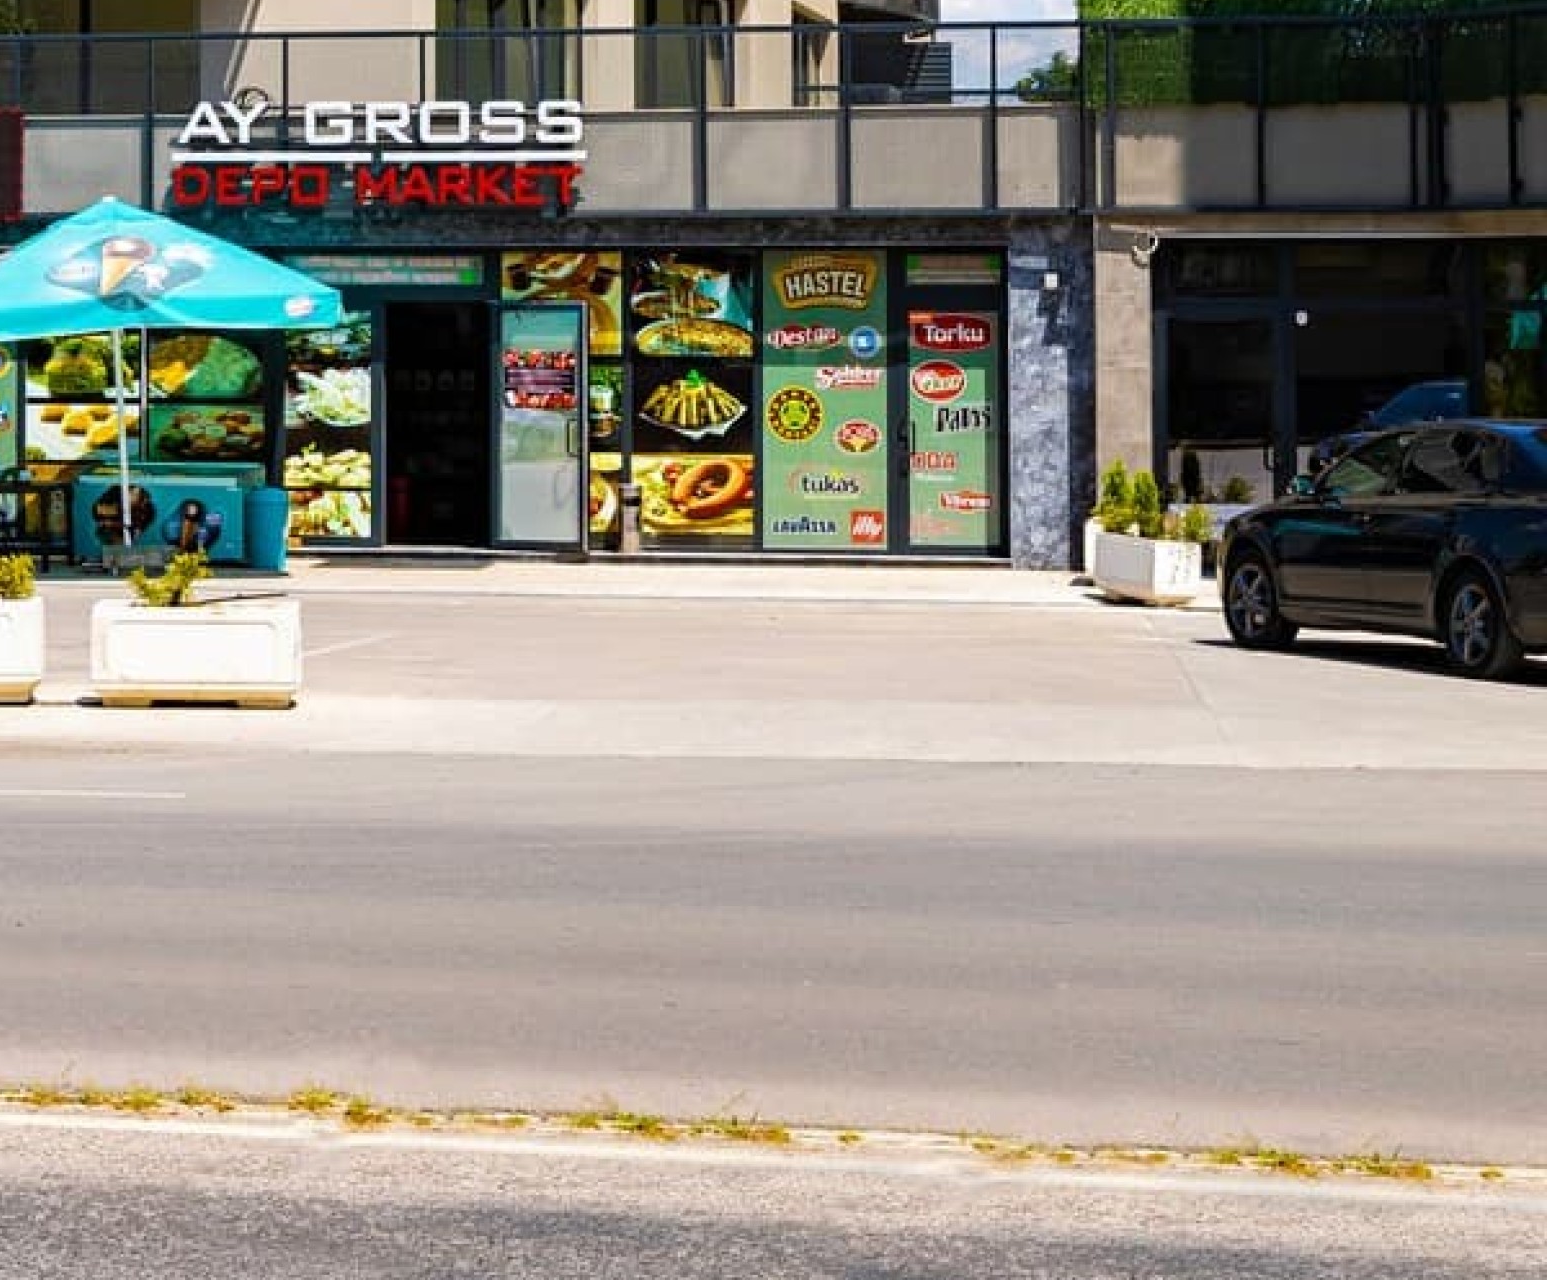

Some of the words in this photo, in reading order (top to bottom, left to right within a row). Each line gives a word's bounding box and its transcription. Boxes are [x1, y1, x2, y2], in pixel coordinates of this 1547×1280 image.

[178, 100, 269, 145] AY
[305, 100, 584, 145] GROSS
[171, 164, 330, 208] DEPO
[354, 164, 584, 208] MARKET
[784, 270, 866, 299] HASTEL
[922, 322, 984, 343] Torku
